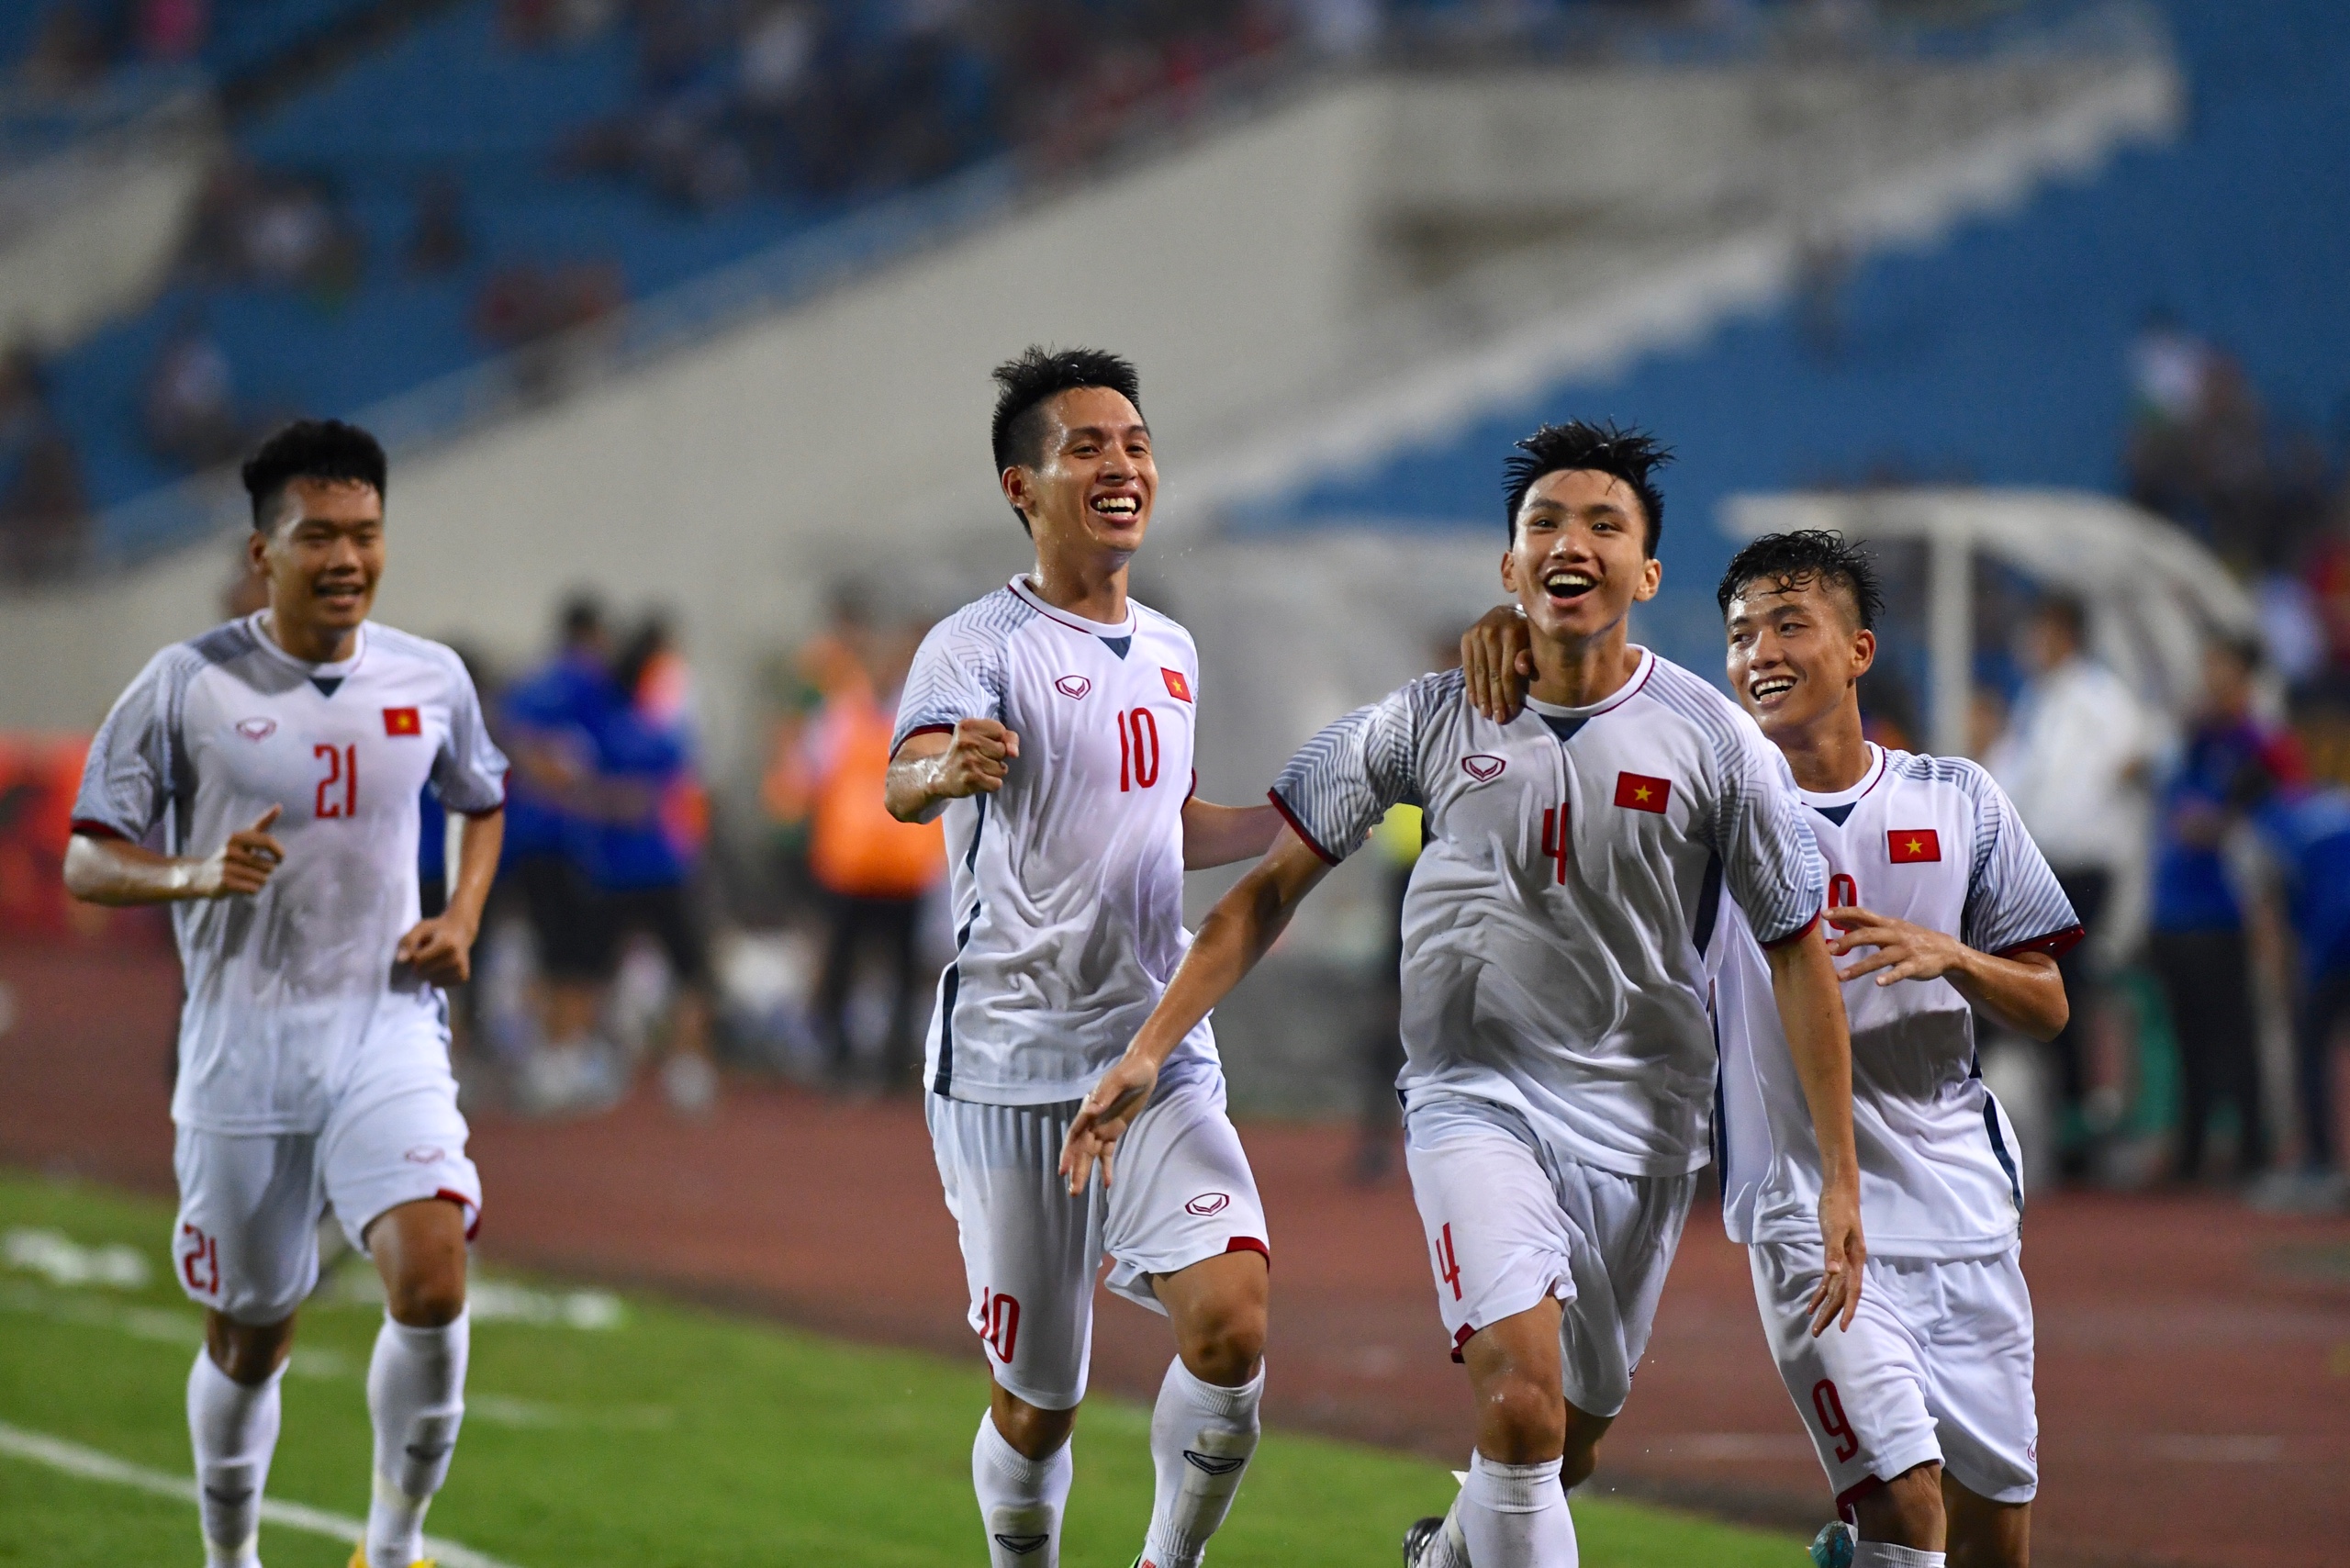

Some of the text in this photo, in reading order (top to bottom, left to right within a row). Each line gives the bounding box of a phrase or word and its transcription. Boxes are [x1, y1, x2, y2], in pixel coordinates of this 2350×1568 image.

[314, 743, 357, 820] 21
[1117, 707, 1160, 792] 10
[1541, 801, 1568, 886] 4
[184, 1222, 219, 1296] 21
[1435, 1222, 1462, 1302] 4
[979, 1286, 1021, 1364] 10
[1812, 1378, 1859, 1463] 9
